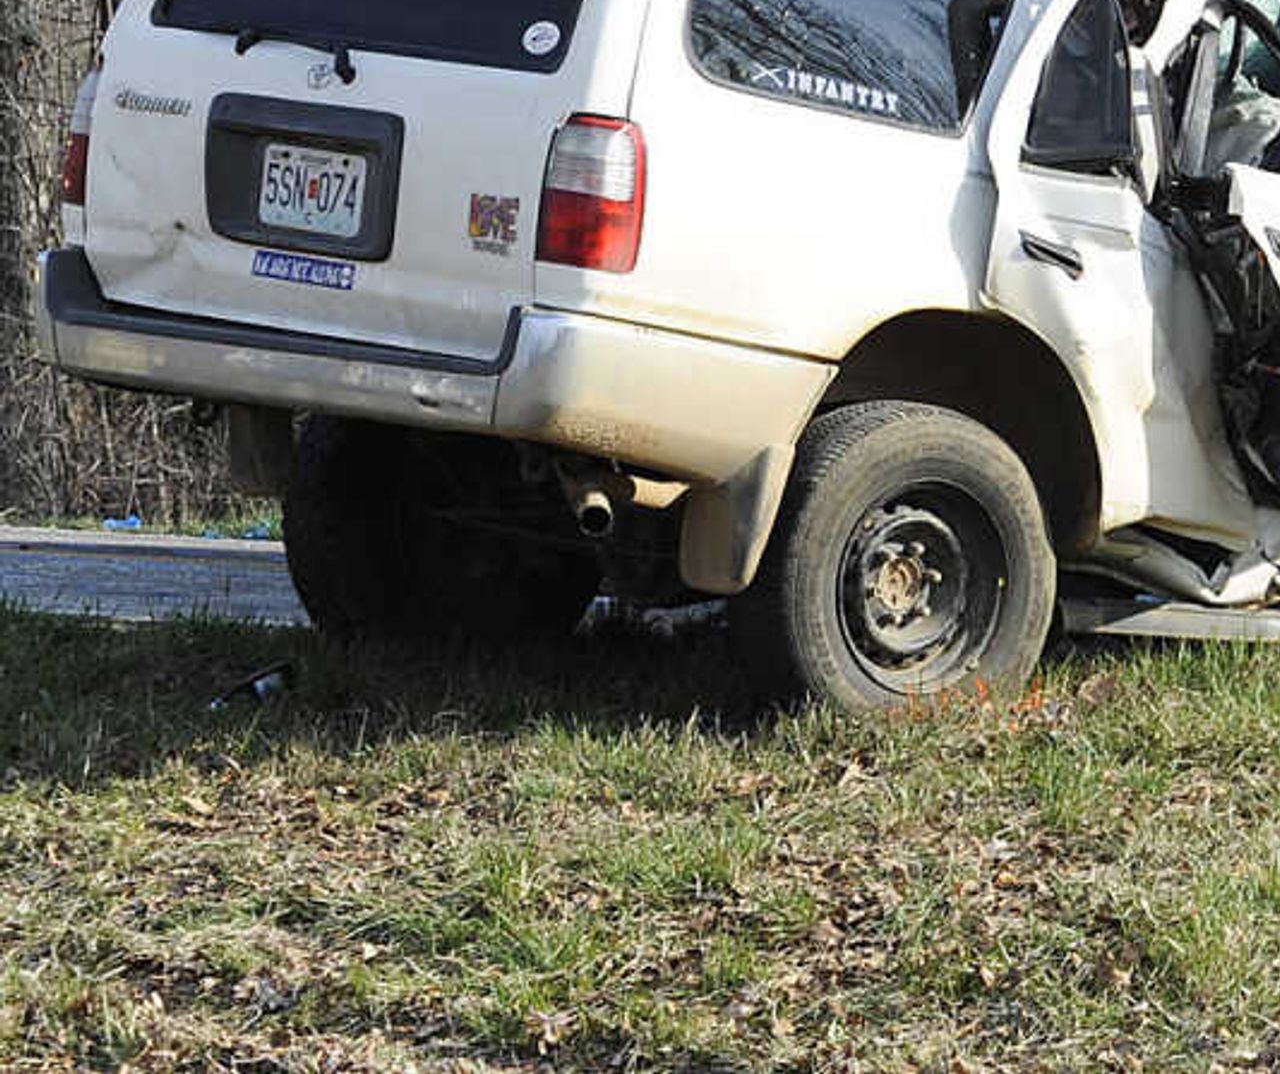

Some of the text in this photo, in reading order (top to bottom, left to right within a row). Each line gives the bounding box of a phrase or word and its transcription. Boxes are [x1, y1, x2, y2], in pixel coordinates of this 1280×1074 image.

[787, 68, 899, 114] INFANTRY
[265, 161, 359, 219] 5SN 074
